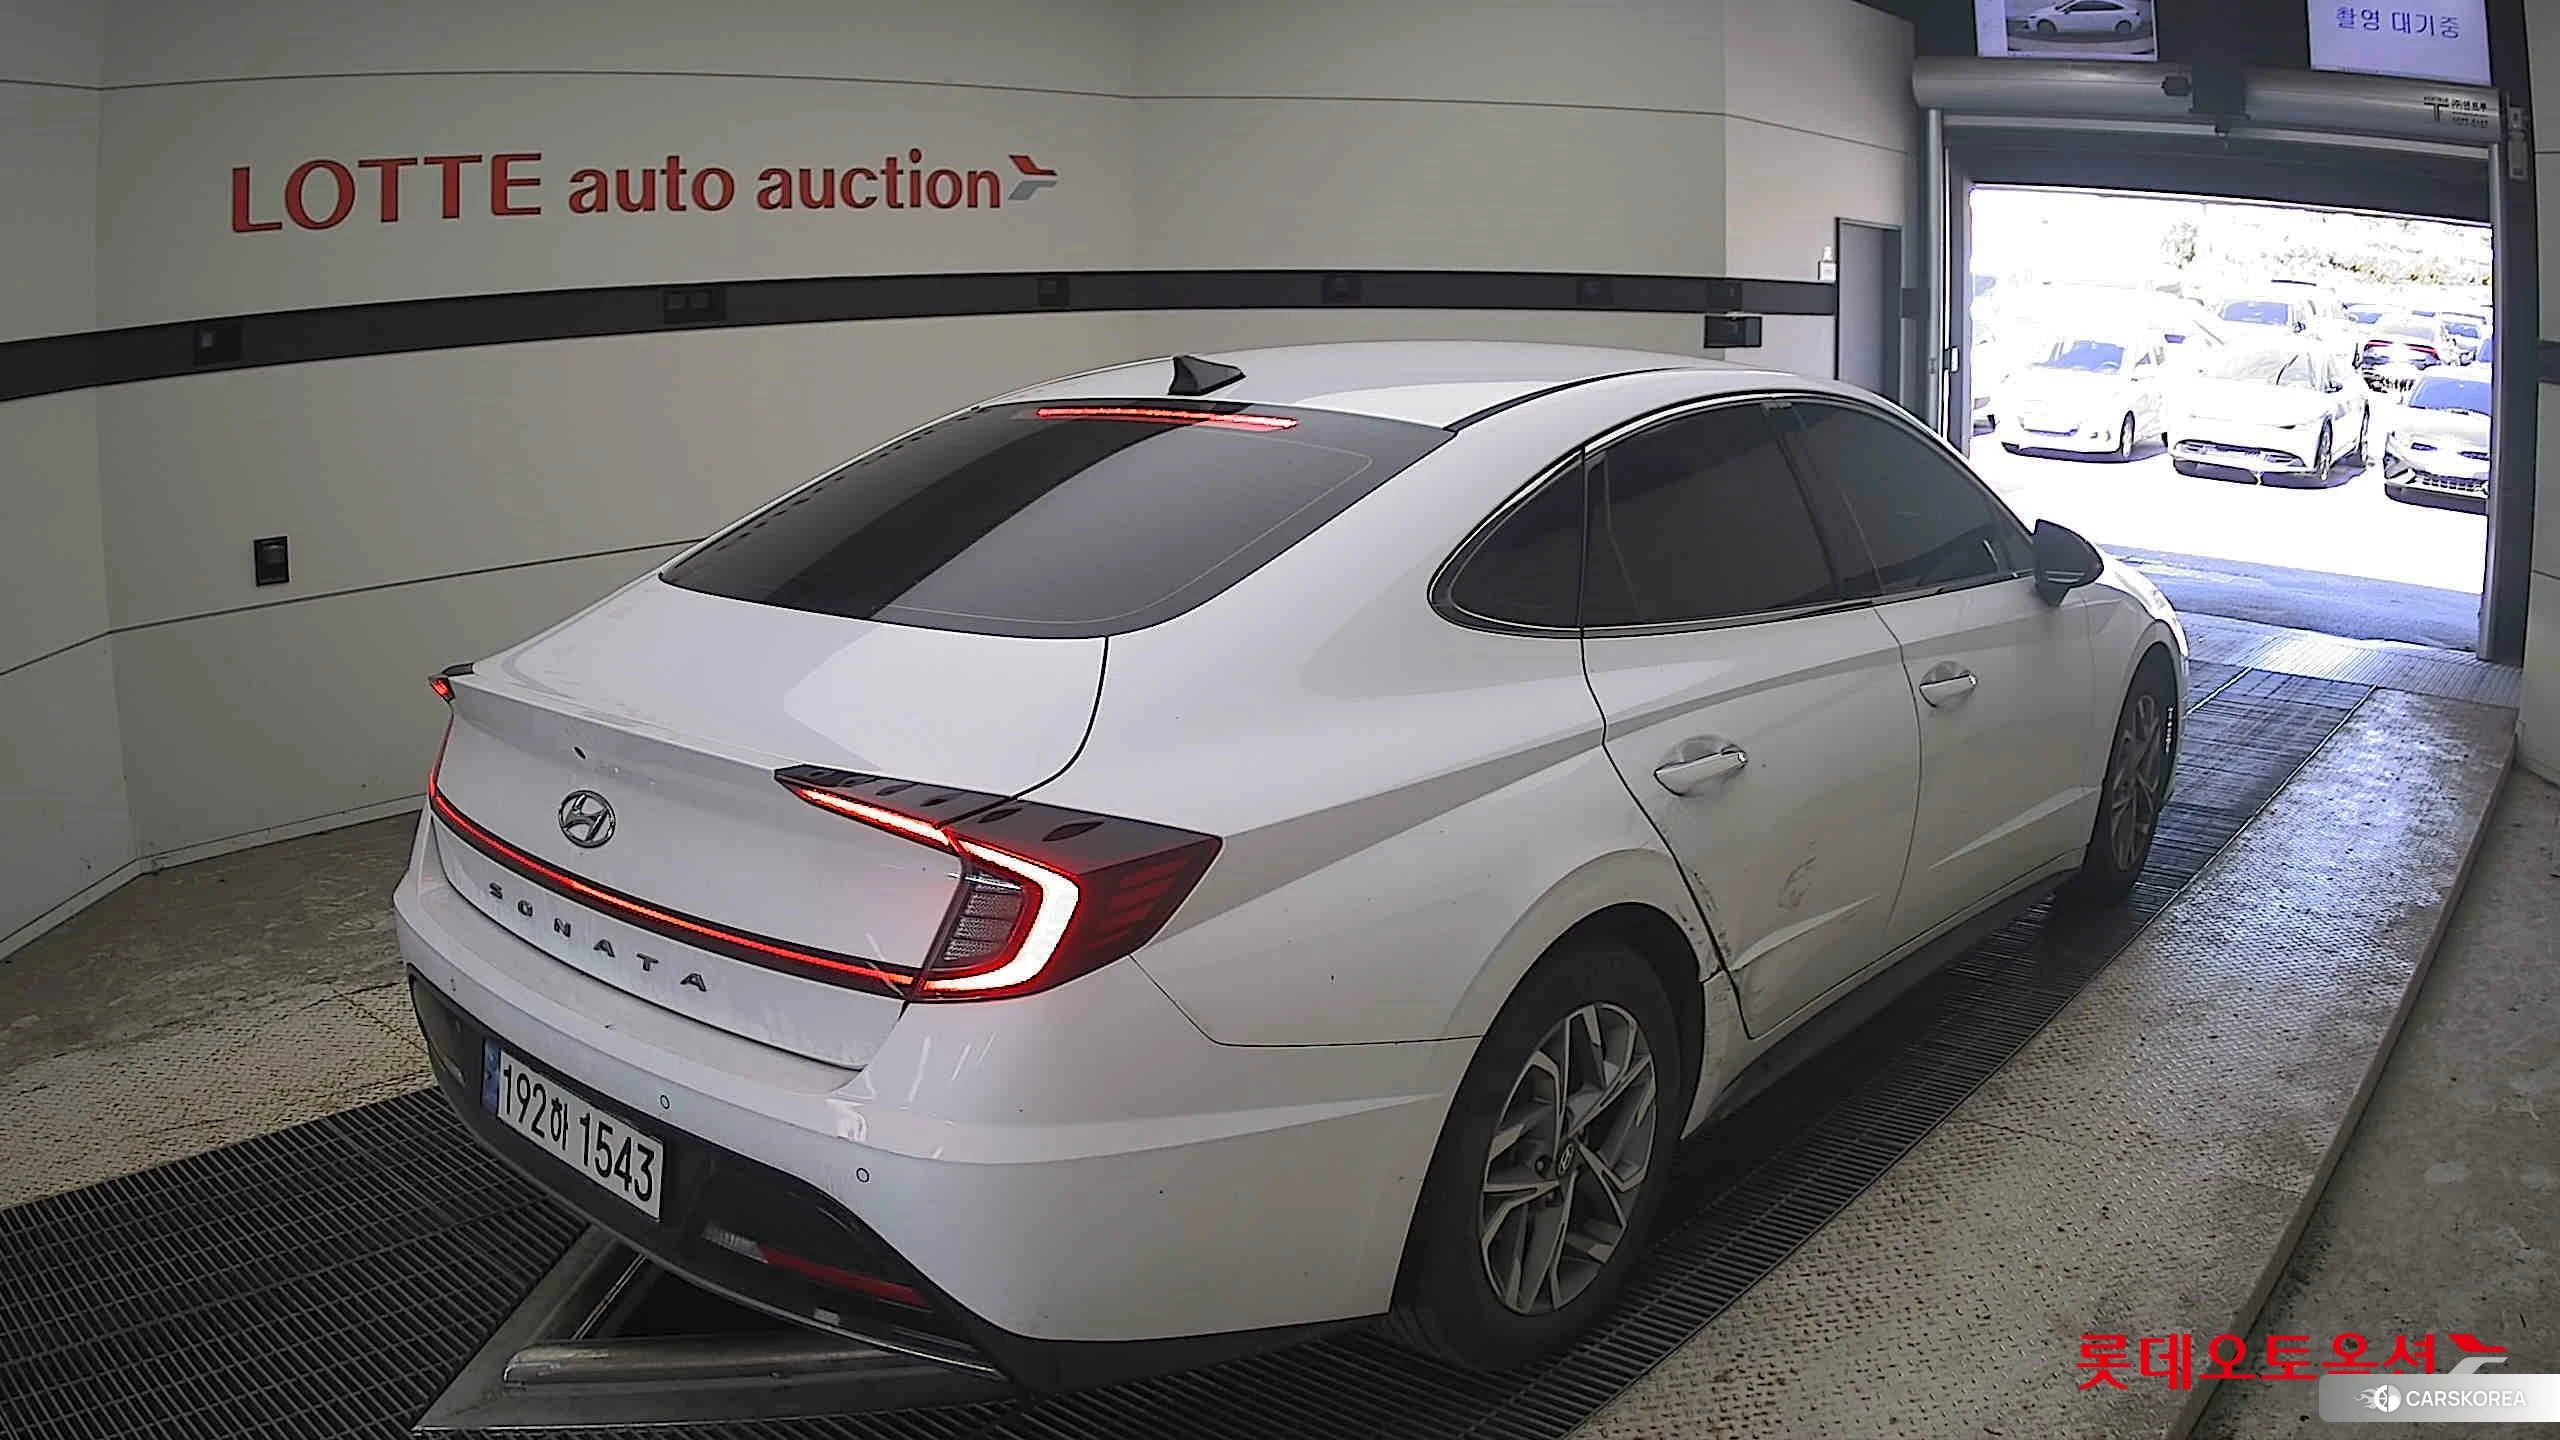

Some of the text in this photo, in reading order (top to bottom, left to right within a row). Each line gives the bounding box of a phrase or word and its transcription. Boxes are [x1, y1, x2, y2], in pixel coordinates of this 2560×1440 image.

[2391, 11, 2459, 39] 대기중
[232, 148, 1001, 233] LOTTE auto auction
[488, 881, 708, 993] SONATA
[504, 1064, 654, 1202] 192하 1543
